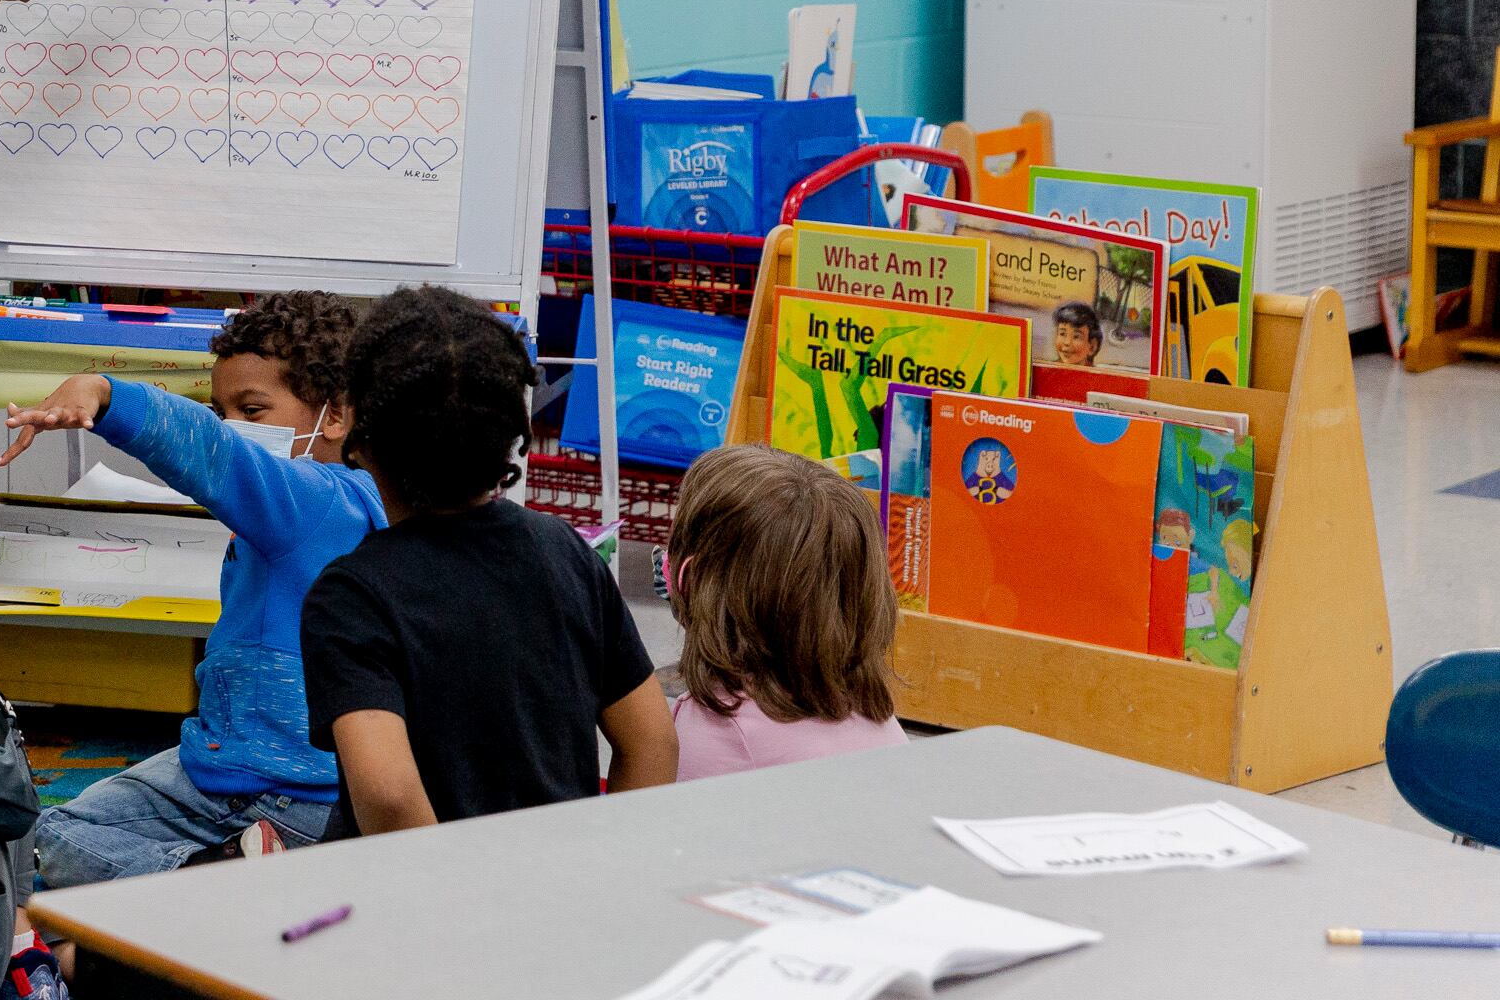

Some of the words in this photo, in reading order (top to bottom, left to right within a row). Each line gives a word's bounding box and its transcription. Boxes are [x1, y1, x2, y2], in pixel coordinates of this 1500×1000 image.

[668, 146, 728, 177] Rigby
[668, 181, 698, 190] LEVELED
[699, 180, 728, 189] LIBRARY
[695, 211, 707, 226] C
[1167, 200, 1230, 249] Day!
[824, 245, 880, 272] What
[885, 252, 922, 277] Am
[929, 256, 947, 279] I?
[996, 247, 1033, 272] and
[1039, 252, 1086, 282] Peter
[817, 271, 885, 298] Where
[891, 281, 928, 304] Am
[936, 285, 954, 307] I?
[808, 313, 828, 339] In
[836, 317, 875, 345] the
[672, 338, 717, 357] Reading
[636, 355, 673, 372] Start
[675, 361, 713, 379] Right
[643, 372, 700, 393] Readers
[807, 344, 851, 380] Tall,
[855, 350, 893, 379] Tall
[898, 356, 967, 390] Grass
[980, 410, 1032, 433] Reading
